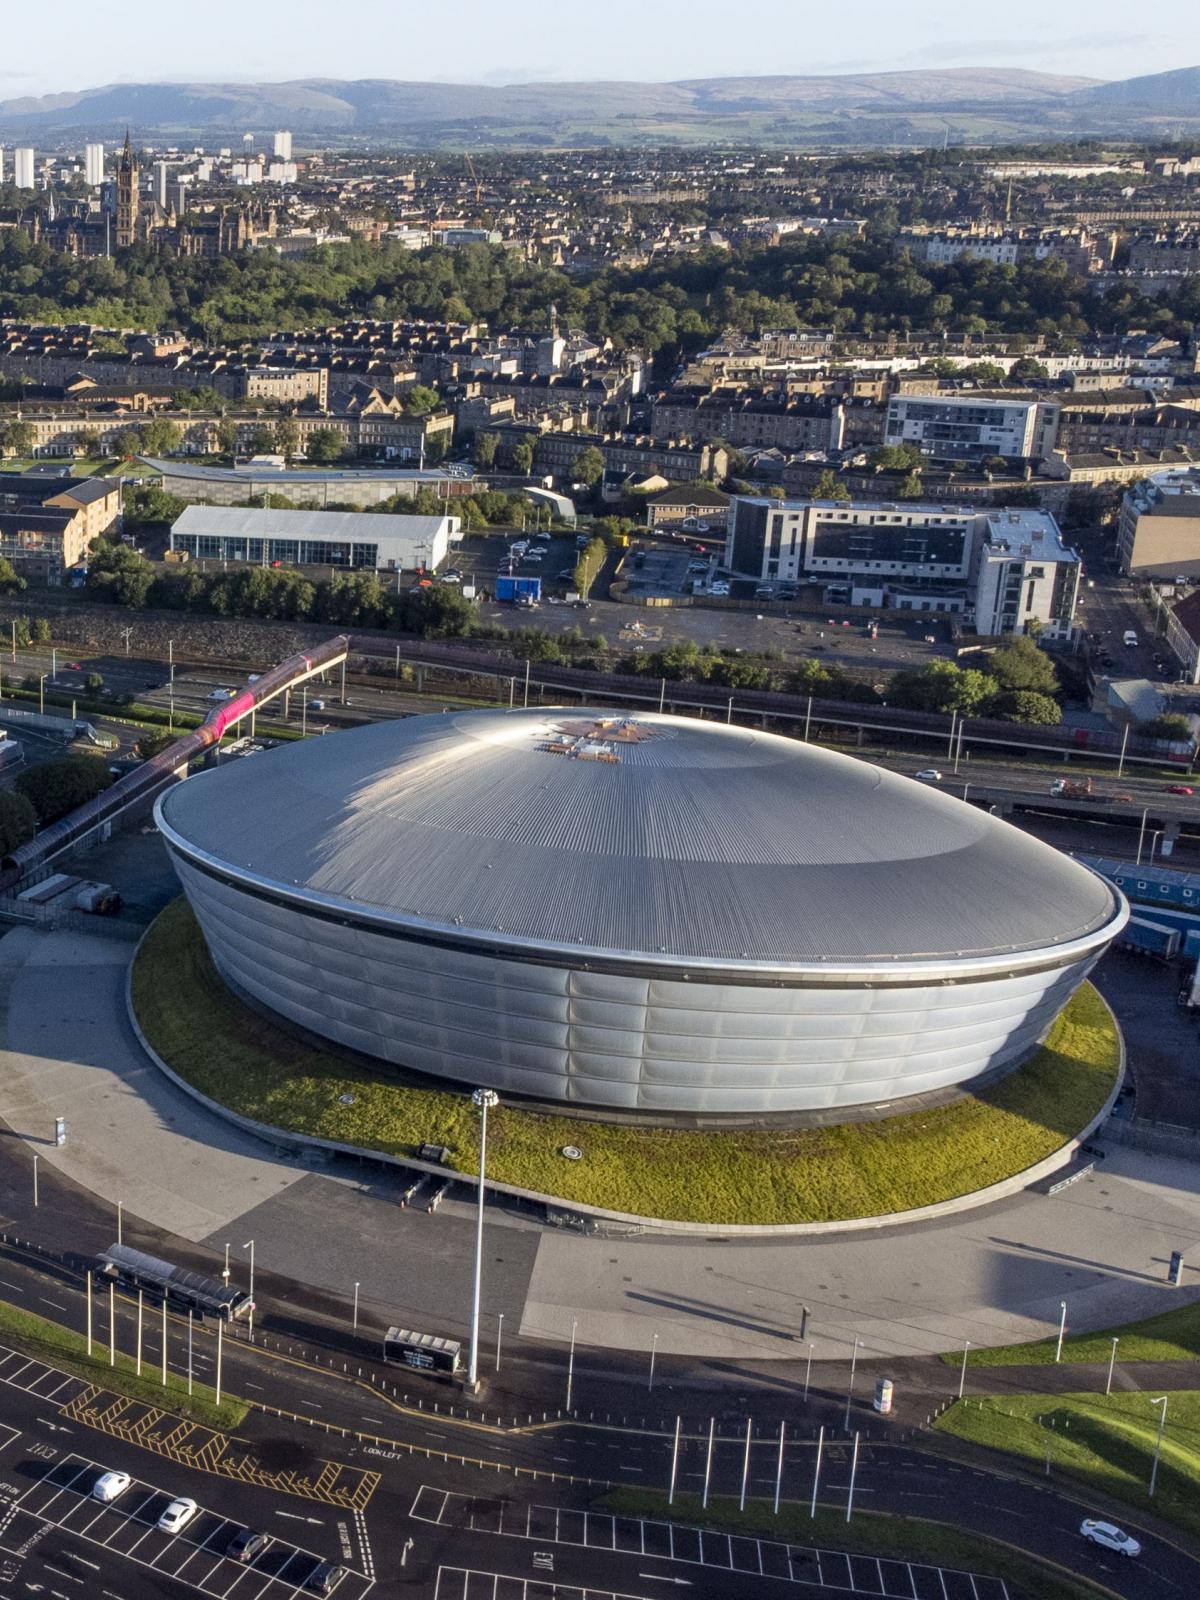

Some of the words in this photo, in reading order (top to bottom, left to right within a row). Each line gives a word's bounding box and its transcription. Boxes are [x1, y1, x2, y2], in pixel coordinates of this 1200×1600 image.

[26, 1442, 58, 1459] EXIT
[363, 1446, 382, 1456] LOOK
[382, 1451, 402, 1460] LEFT
[532, 1551, 554, 1572] EXIT
